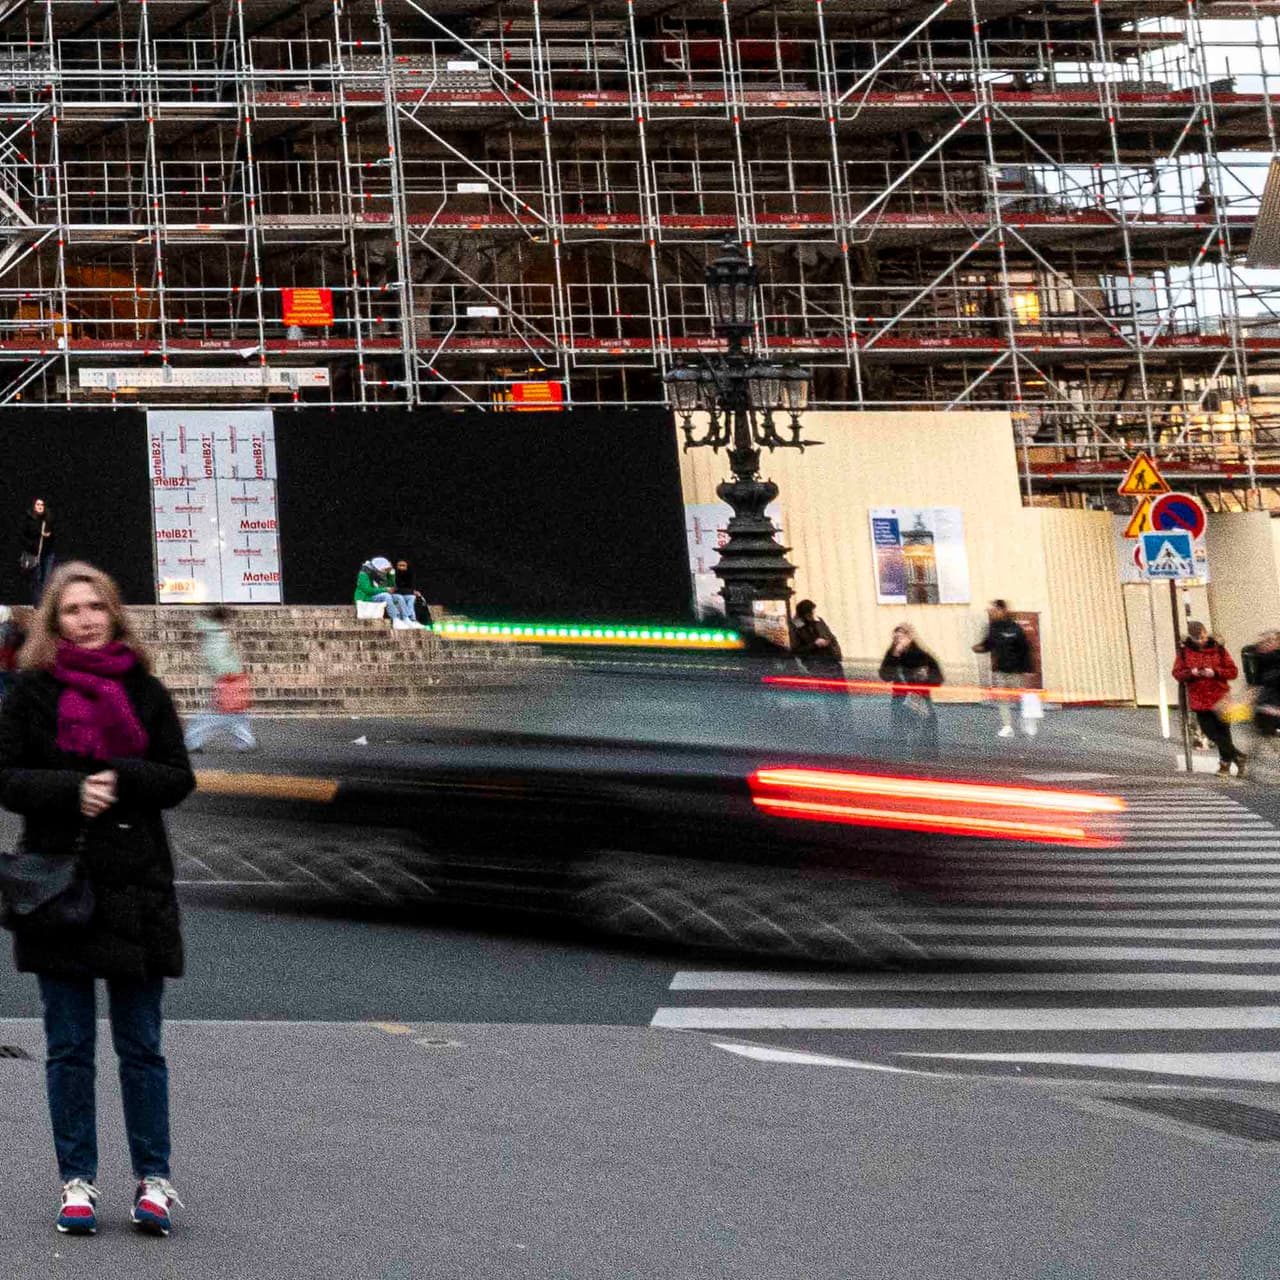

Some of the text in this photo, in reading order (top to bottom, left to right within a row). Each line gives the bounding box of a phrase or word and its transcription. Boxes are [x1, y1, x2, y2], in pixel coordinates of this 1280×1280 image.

[152, 437, 162, 478] atelB21
[202, 437, 213, 479] atelB21
[253, 437, 263, 479] atelB21
